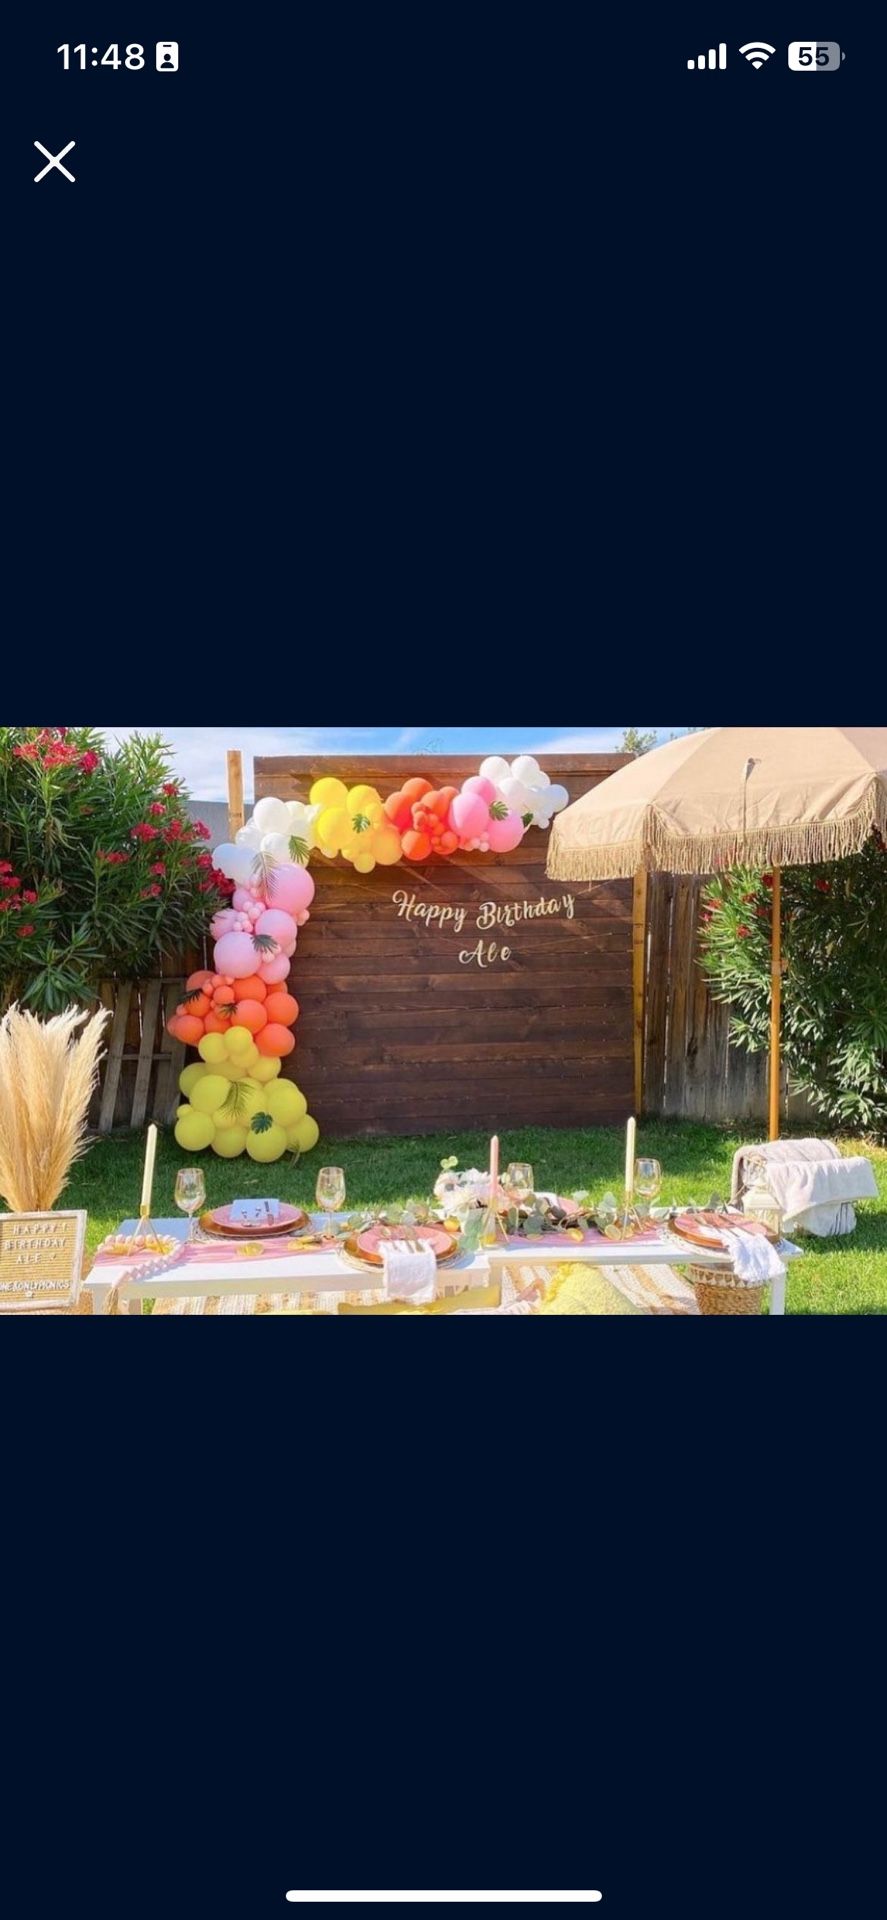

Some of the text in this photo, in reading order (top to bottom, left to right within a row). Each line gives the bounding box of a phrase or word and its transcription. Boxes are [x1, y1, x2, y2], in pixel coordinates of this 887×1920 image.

[392, 889, 575, 933] Happy Birthday
[458, 939, 512, 968] Ale
[4, 1237, 66, 1250] BIRTHDAY
[15, 1252, 41, 1264] ALE
